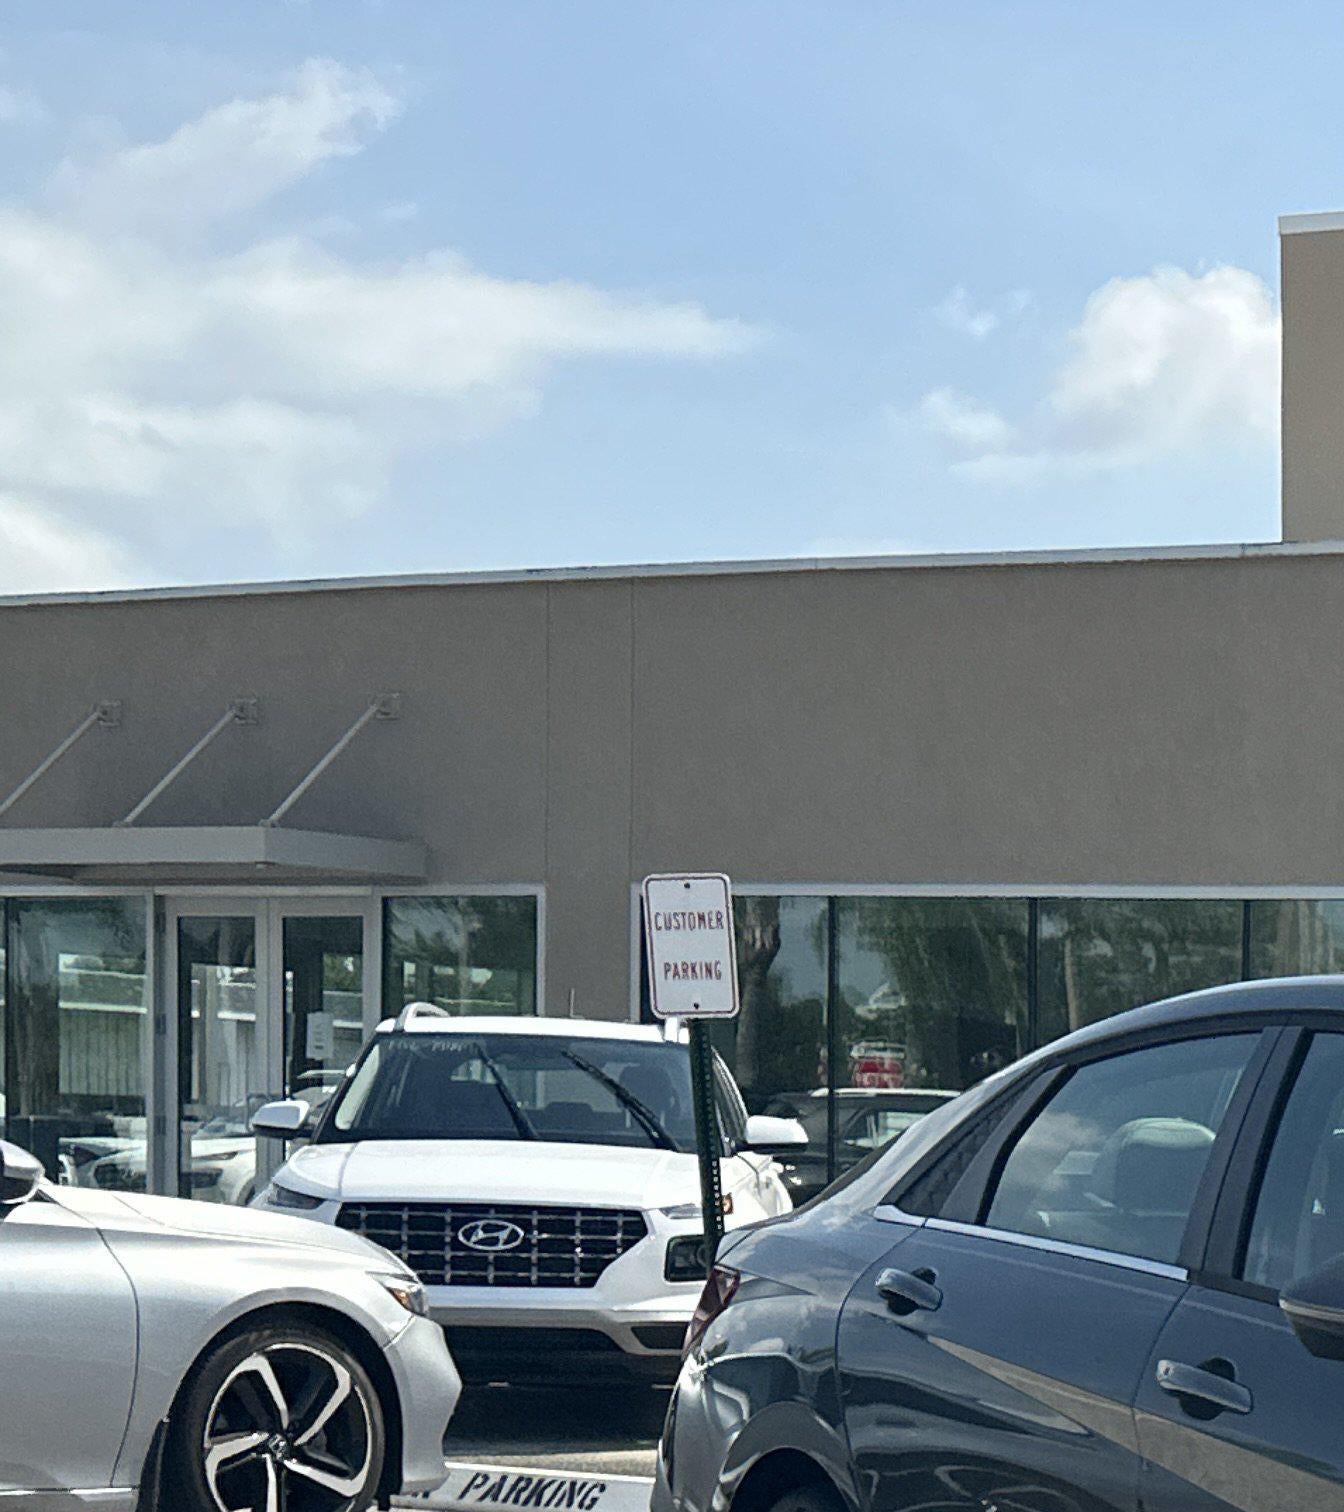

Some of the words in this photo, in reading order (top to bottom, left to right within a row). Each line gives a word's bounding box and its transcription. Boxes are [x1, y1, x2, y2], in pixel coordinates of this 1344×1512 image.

[654, 910, 724, 931] CUSTOMER
[664, 960, 722, 981] PARKING
[458, 1471, 606, 1511] PARKING
